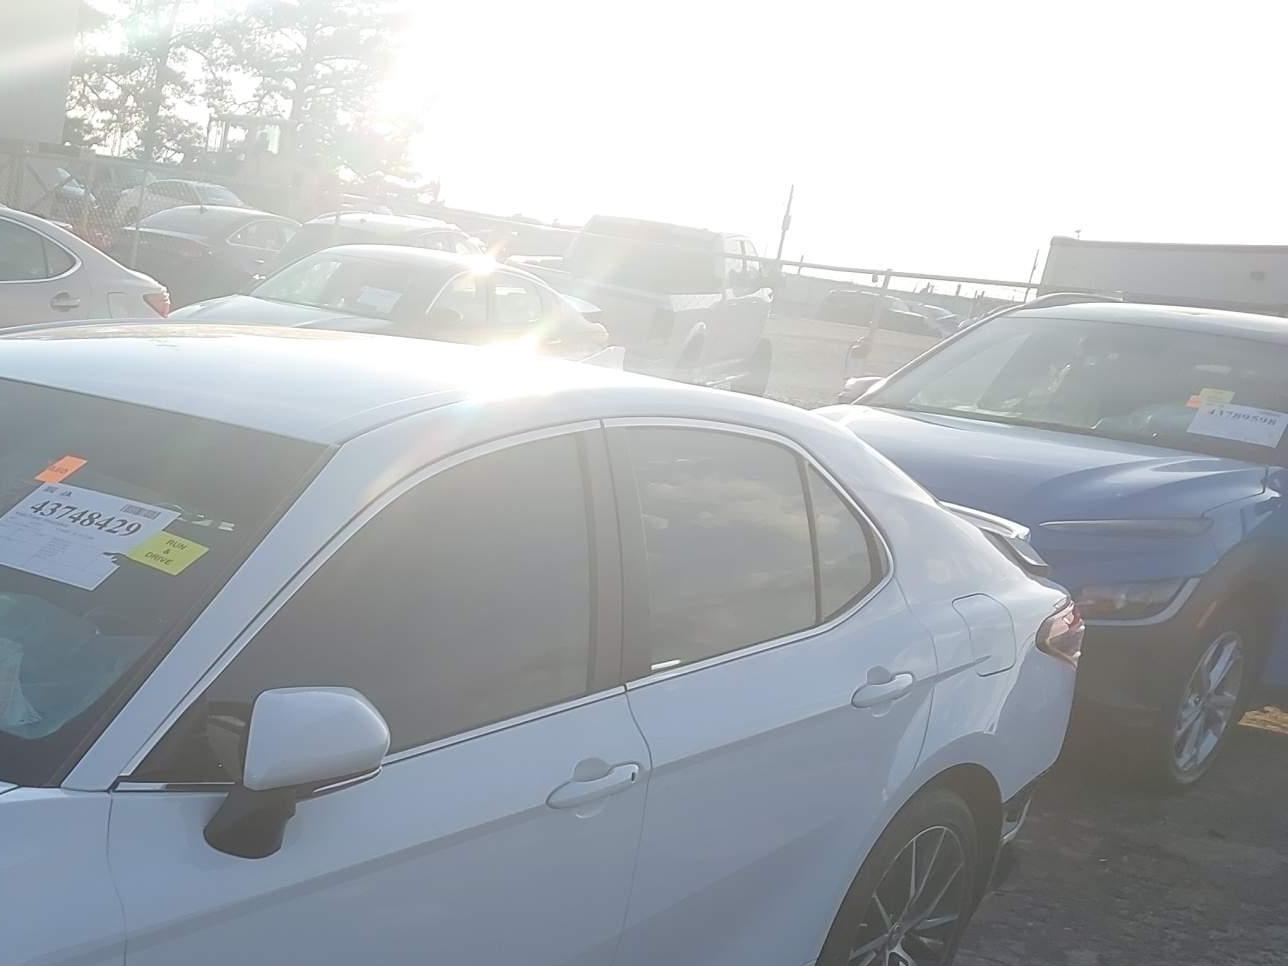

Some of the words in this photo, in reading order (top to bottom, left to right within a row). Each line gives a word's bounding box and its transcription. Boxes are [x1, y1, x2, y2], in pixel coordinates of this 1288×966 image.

[30, 500, 142, 537] 43748429
[166, 539, 188, 551] RUN
[144, 551, 174, 566] DRIVE
